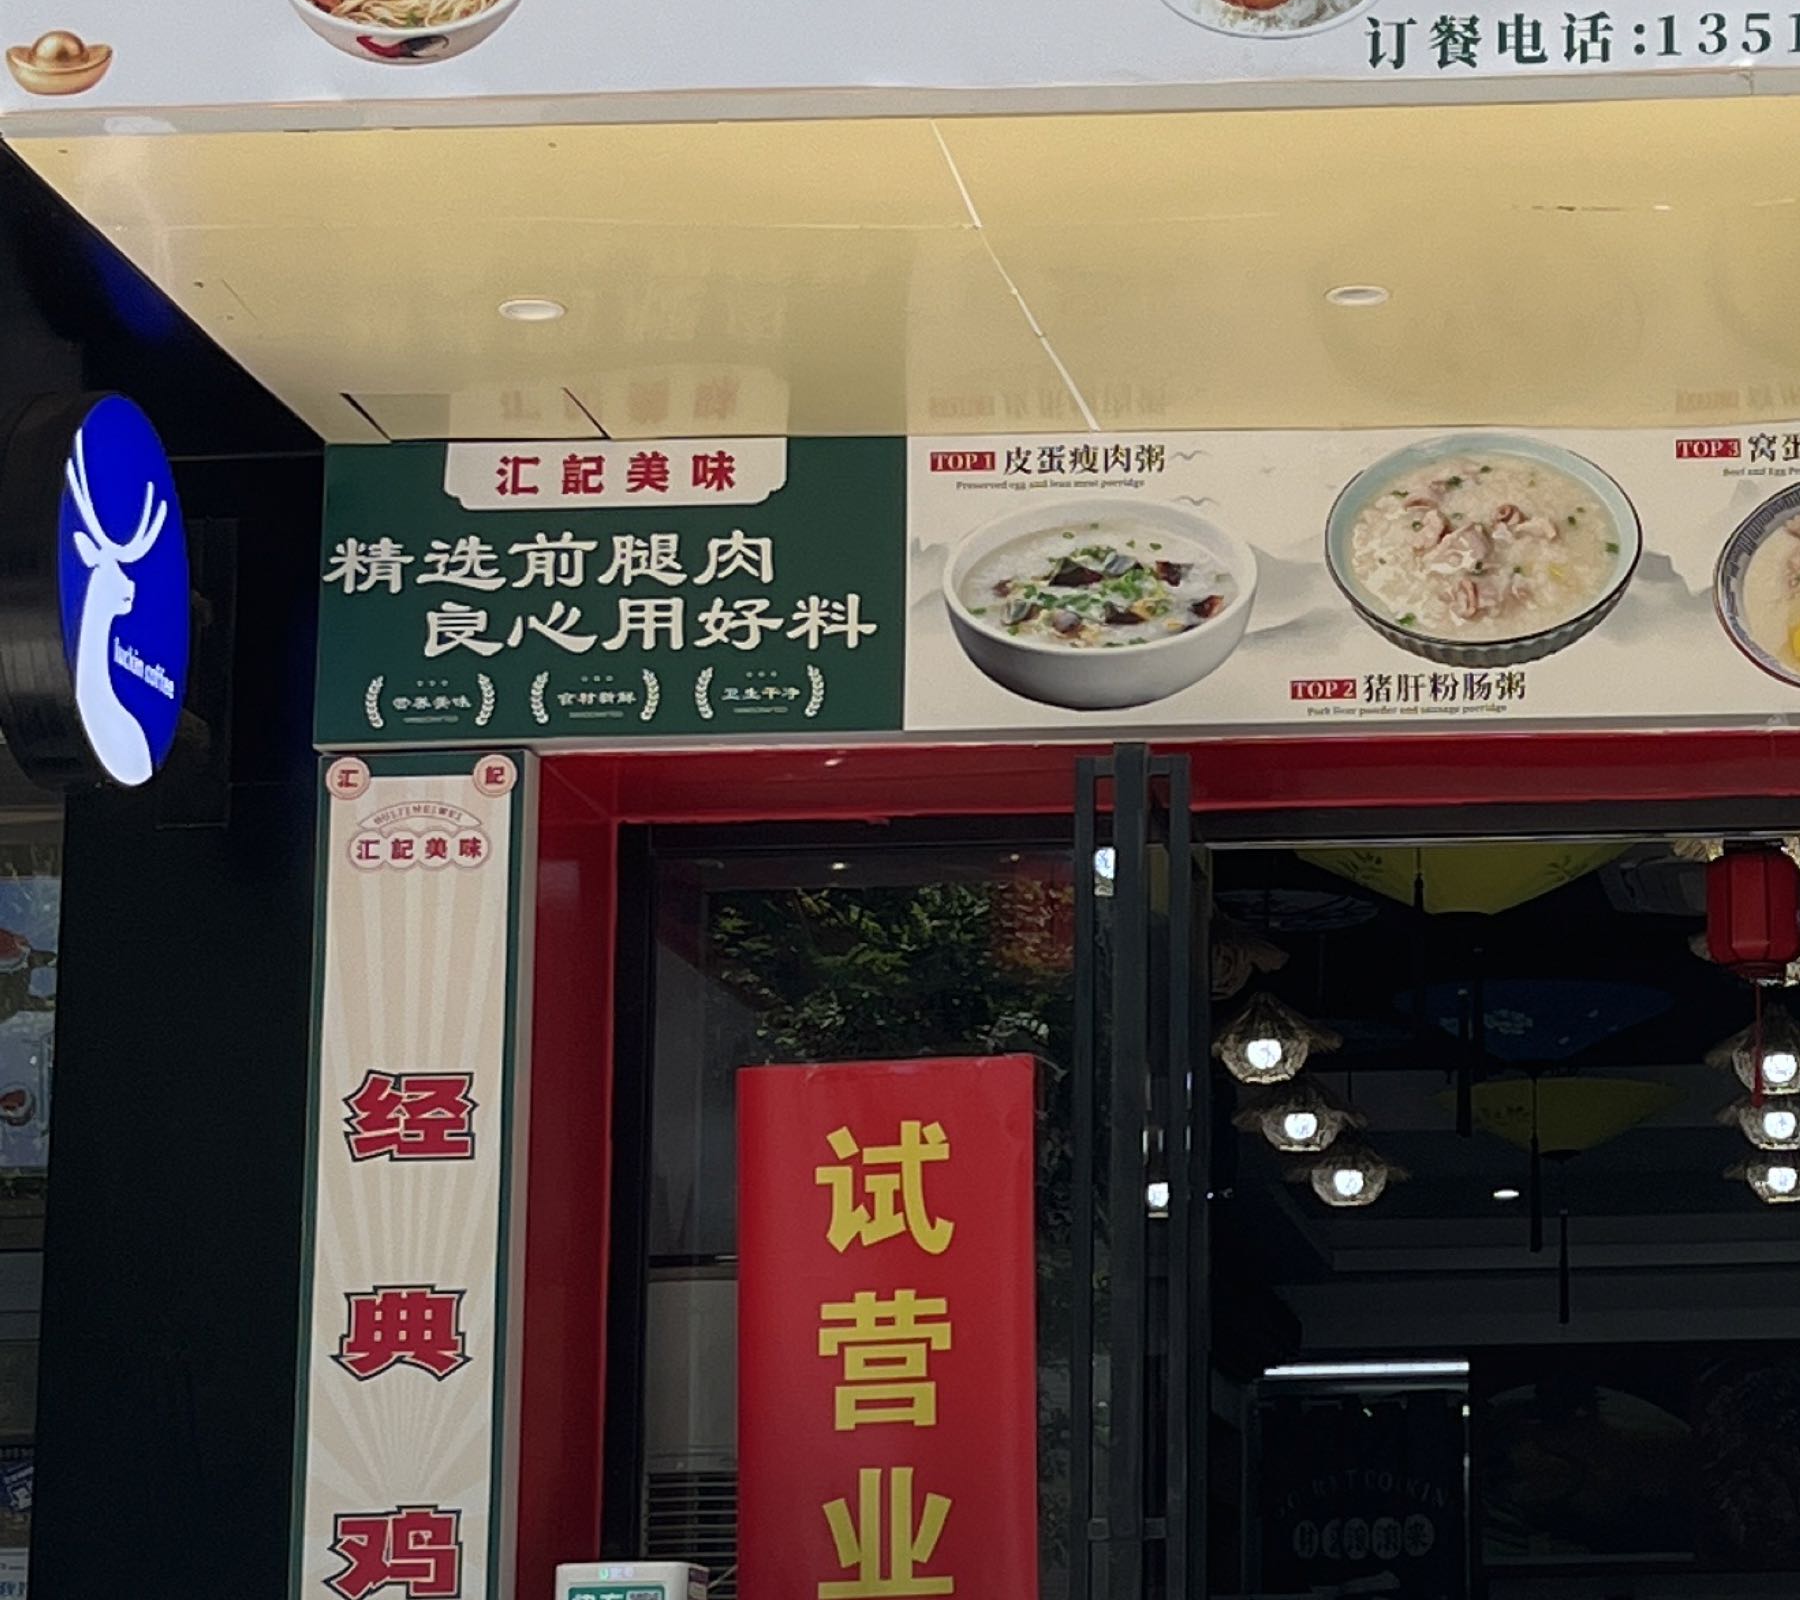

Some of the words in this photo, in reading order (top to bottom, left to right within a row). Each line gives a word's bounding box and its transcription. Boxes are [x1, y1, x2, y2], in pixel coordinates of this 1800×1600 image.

[933, 453, 977, 471] TOP
[1003, 444, 1166, 475] 皮蛋瘦肉粥
[1677, 441, 1724, 458] TOP
[495, 450, 736, 497] 汇記美味
[323, 529, 775, 594] 精选前腿肉
[423, 592, 878, 657] 良心用好料
[1292, 681, 1339, 699] TOP
[1363, 672, 1526, 703] 猪肝粉肠粥
[336, 768, 360, 789] 汇
[356, 836, 482, 860] 汇記美味
[815, 1120, 955, 1600] 试营业
